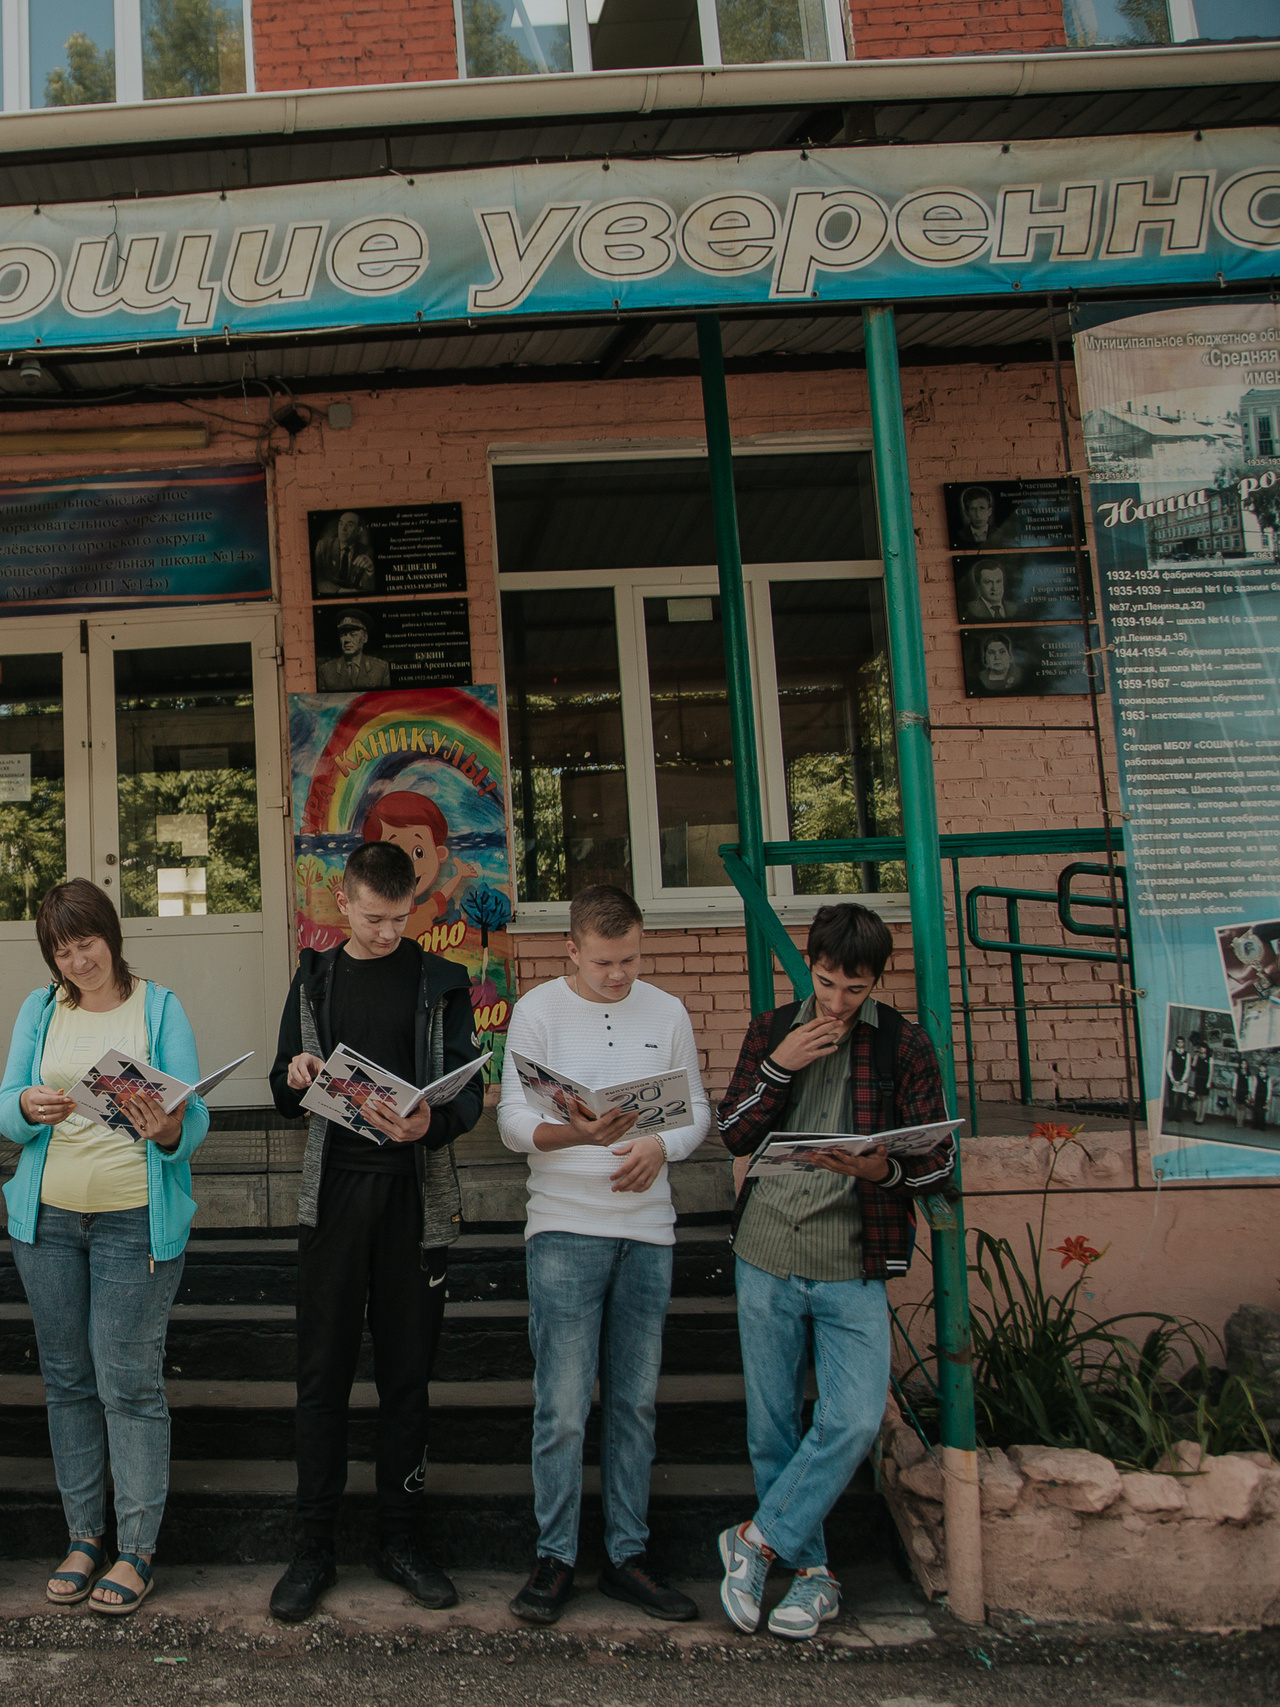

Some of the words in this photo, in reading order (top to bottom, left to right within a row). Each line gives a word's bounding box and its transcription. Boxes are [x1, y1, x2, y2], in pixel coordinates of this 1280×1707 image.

[468, 163, 1280, 313] уверенно
[1084, 335, 1184, 352] Муниципальное
[1186, 330, 1257, 348] бюджетное
[1202, 347, 1278, 370] «Средняя
[106, 490, 188, 507] бюджетное
[1097, 489, 1211, 529] Наша
[124, 511, 213, 529] учреждение
[72, 536, 151, 554] городского
[157, 532, 206, 547] округа
[160, 554, 206, 568] школа
[1106, 570, 1160, 581] 1932-1934
[1108, 585, 1161, 596] 1935-1939
[1173, 586, 1203, 595] школа
[1111, 616, 1165, 627] 1939-1944
[1176, 616, 1207, 626] школа
[1114, 647, 1168, 658] 1944-1954
[1159, 664, 1190, 673] школа
[1117, 678, 1170, 689] 1959-1967
[1122, 727, 1136, 739] 34)
[1123, 742, 1163, 752] Сегодня
[1164, 740, 1193, 751] МБОУ
[333, 726, 498, 797] КАНИКУЛЫ!
[1191, 785, 1223, 794] Школа
[299, 780, 336, 837] УРА
